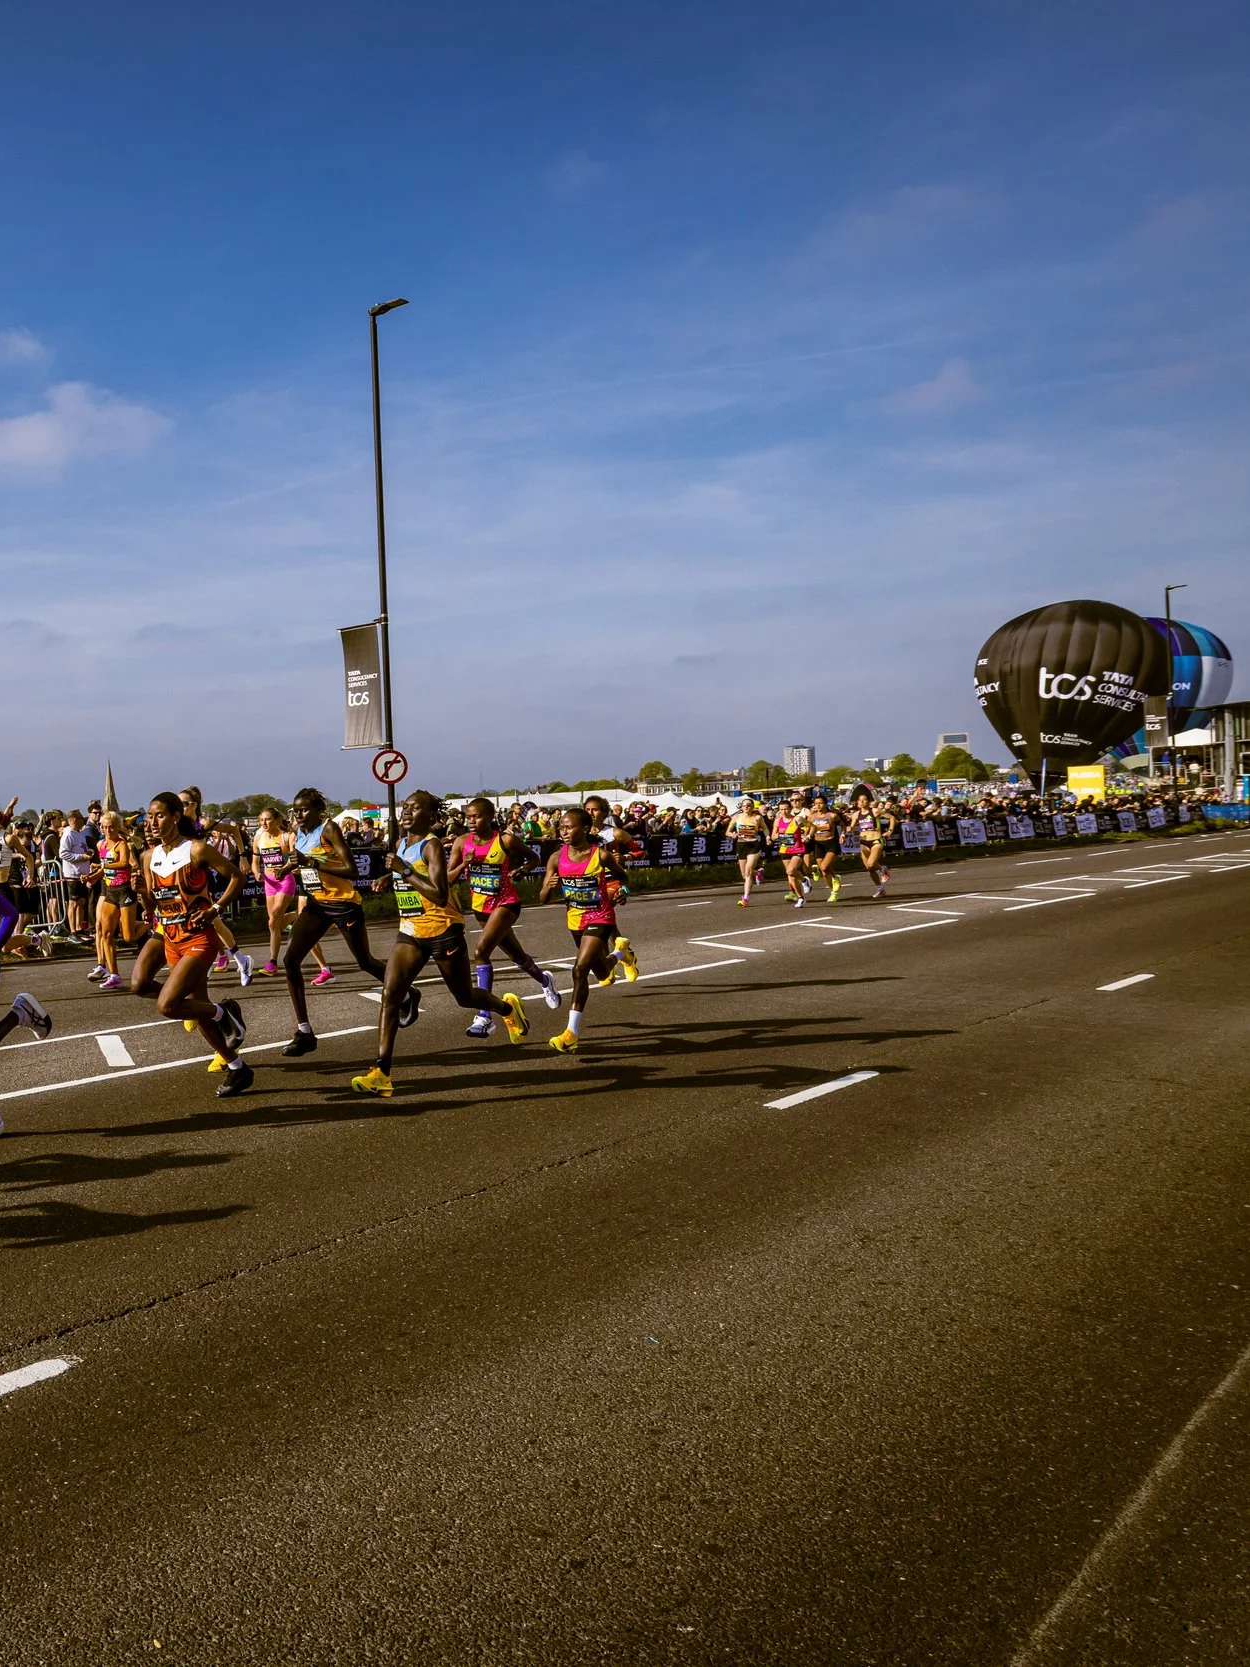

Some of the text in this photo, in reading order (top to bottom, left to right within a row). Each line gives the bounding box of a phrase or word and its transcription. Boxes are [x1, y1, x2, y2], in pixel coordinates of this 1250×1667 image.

[1039, 667, 1097, 700] tcs
[1103, 671, 1134, 686] TATA
[348, 691, 370, 707] tcs
[1092, 694, 1136, 711] SERVICES
[1040, 732, 1061, 744] tcs
[470, 876, 492, 887] PACE
[493, 879, 500, 888] 6
[565, 890, 597, 901] PACE 7
